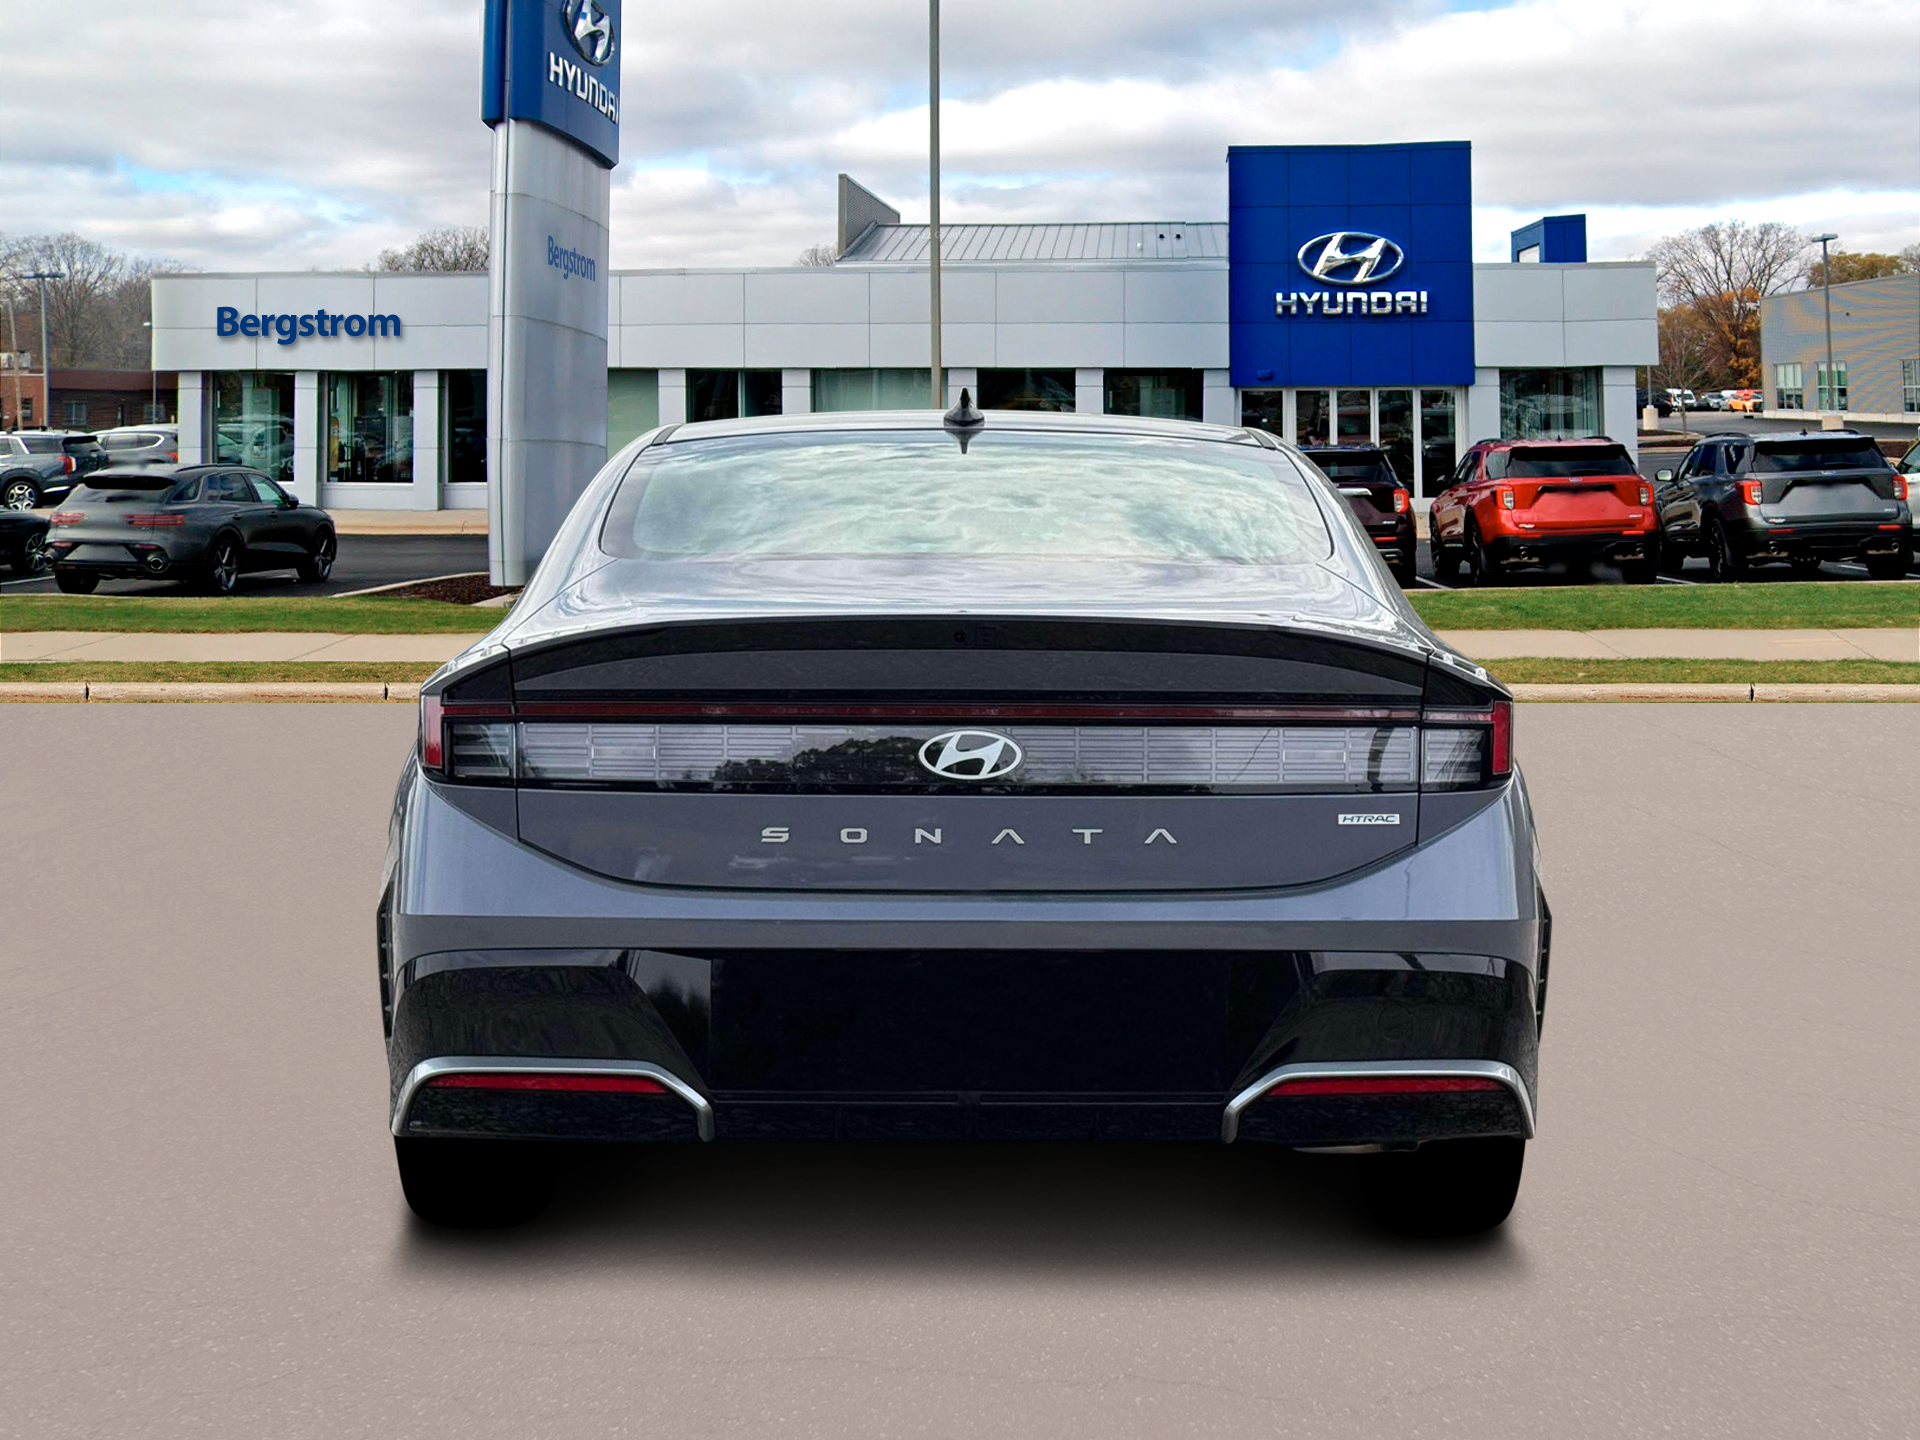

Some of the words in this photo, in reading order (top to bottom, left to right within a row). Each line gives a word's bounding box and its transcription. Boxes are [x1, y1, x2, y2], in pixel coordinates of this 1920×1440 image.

[549, 52, 619, 124] HYUNDAI
[548, 235, 596, 282] Bergstrom
[1275, 291, 1428, 315] HYUNDAI
[216, 306, 402, 346] Bergstrom
[1342, 814, 1396, 823] HTRAC
[760, 826, 1178, 845] SONATA
